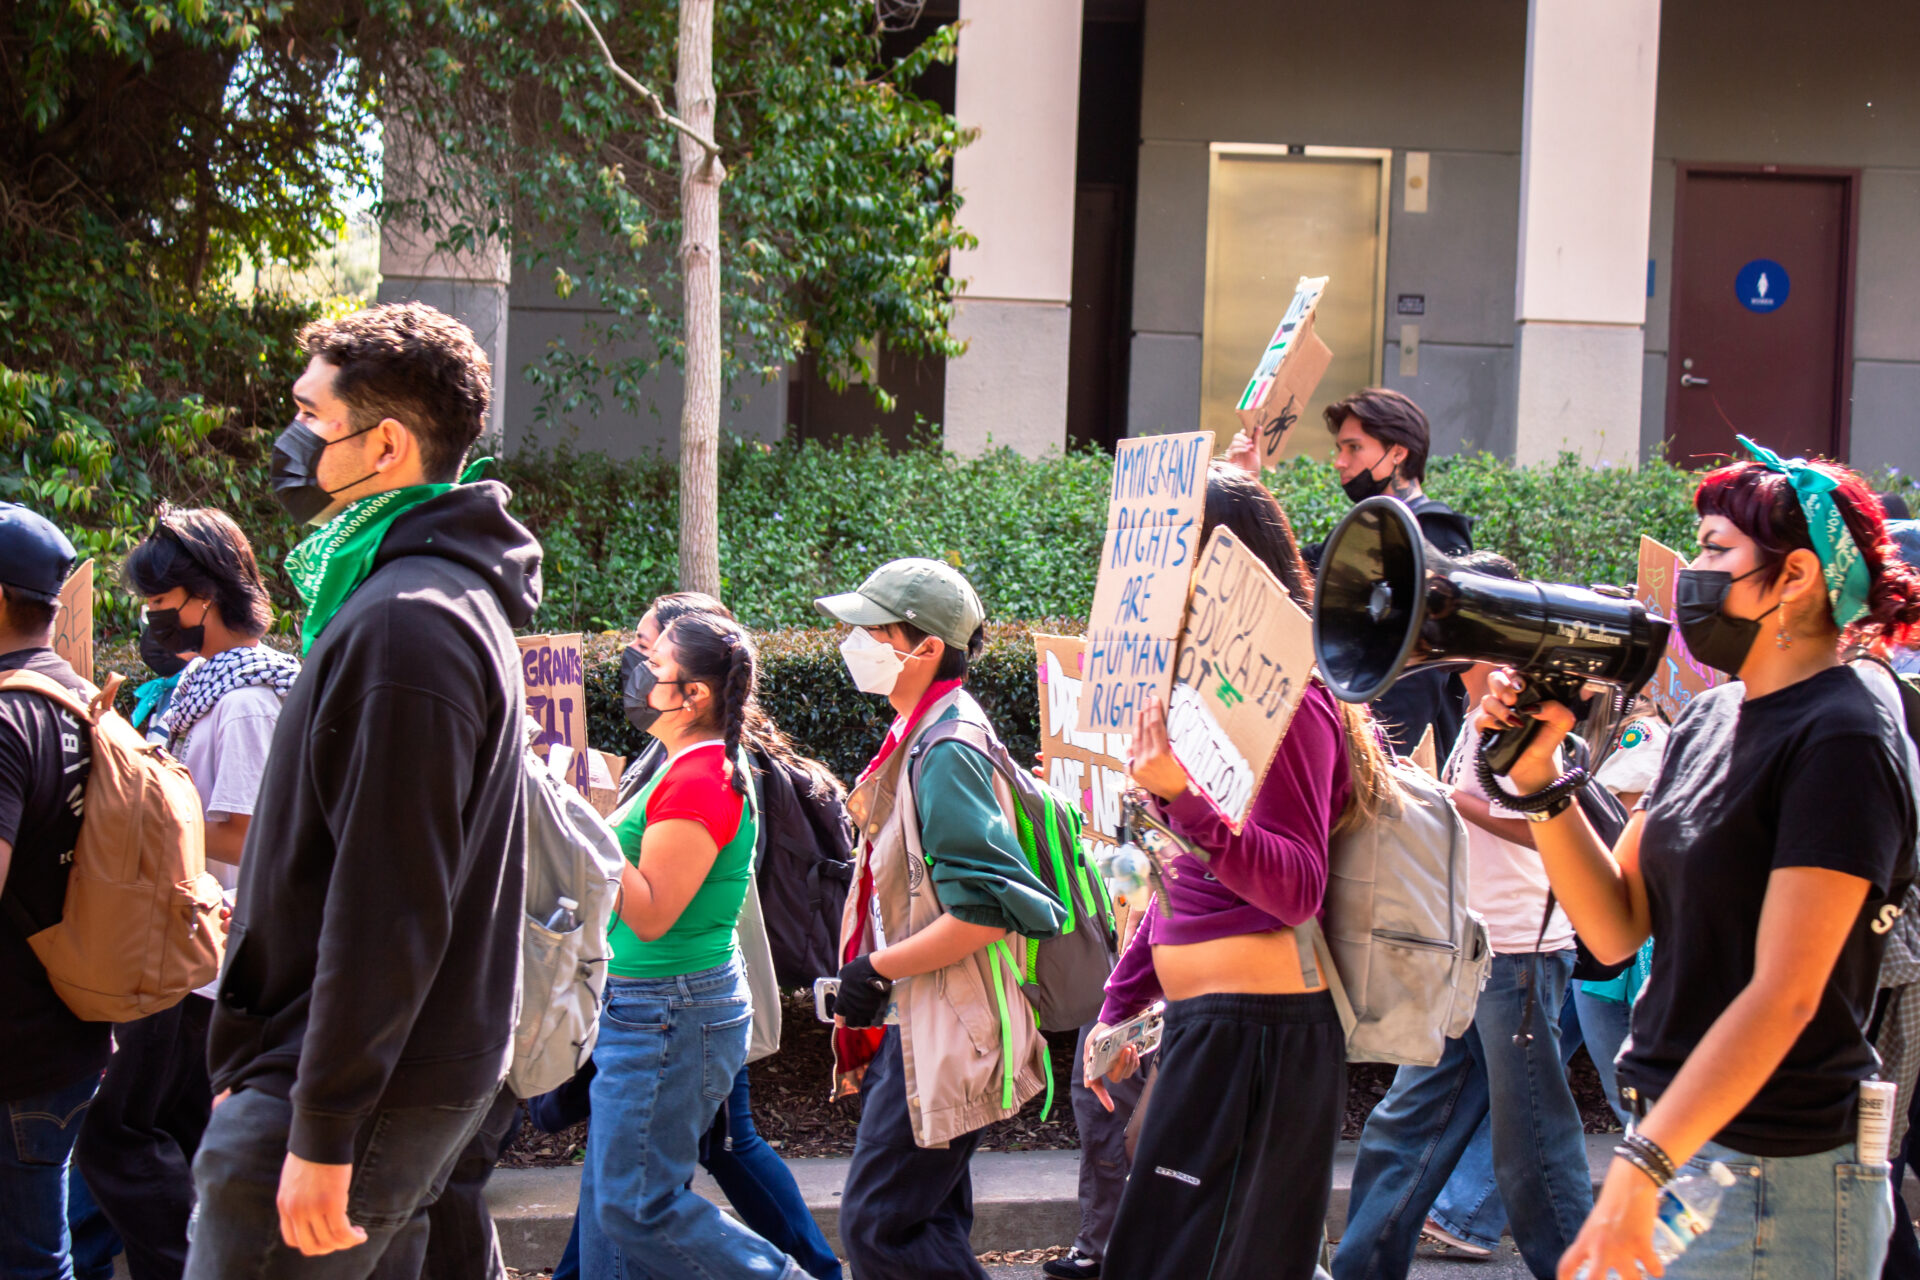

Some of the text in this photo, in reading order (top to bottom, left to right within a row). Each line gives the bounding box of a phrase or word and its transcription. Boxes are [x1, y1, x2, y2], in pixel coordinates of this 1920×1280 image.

[1115, 437, 1204, 500] IMMIGRANT
[1111, 507, 1193, 569] RIGHTS
[1115, 573, 1155, 624] ARE
[1203, 535, 1267, 636] FUND
[523, 645, 582, 687] GRANTS
[1089, 626, 1170, 681] HUMAN
[1177, 646, 1212, 692] OT
[526, 695, 574, 746] ILT
[1871, 904, 1902, 935] S
